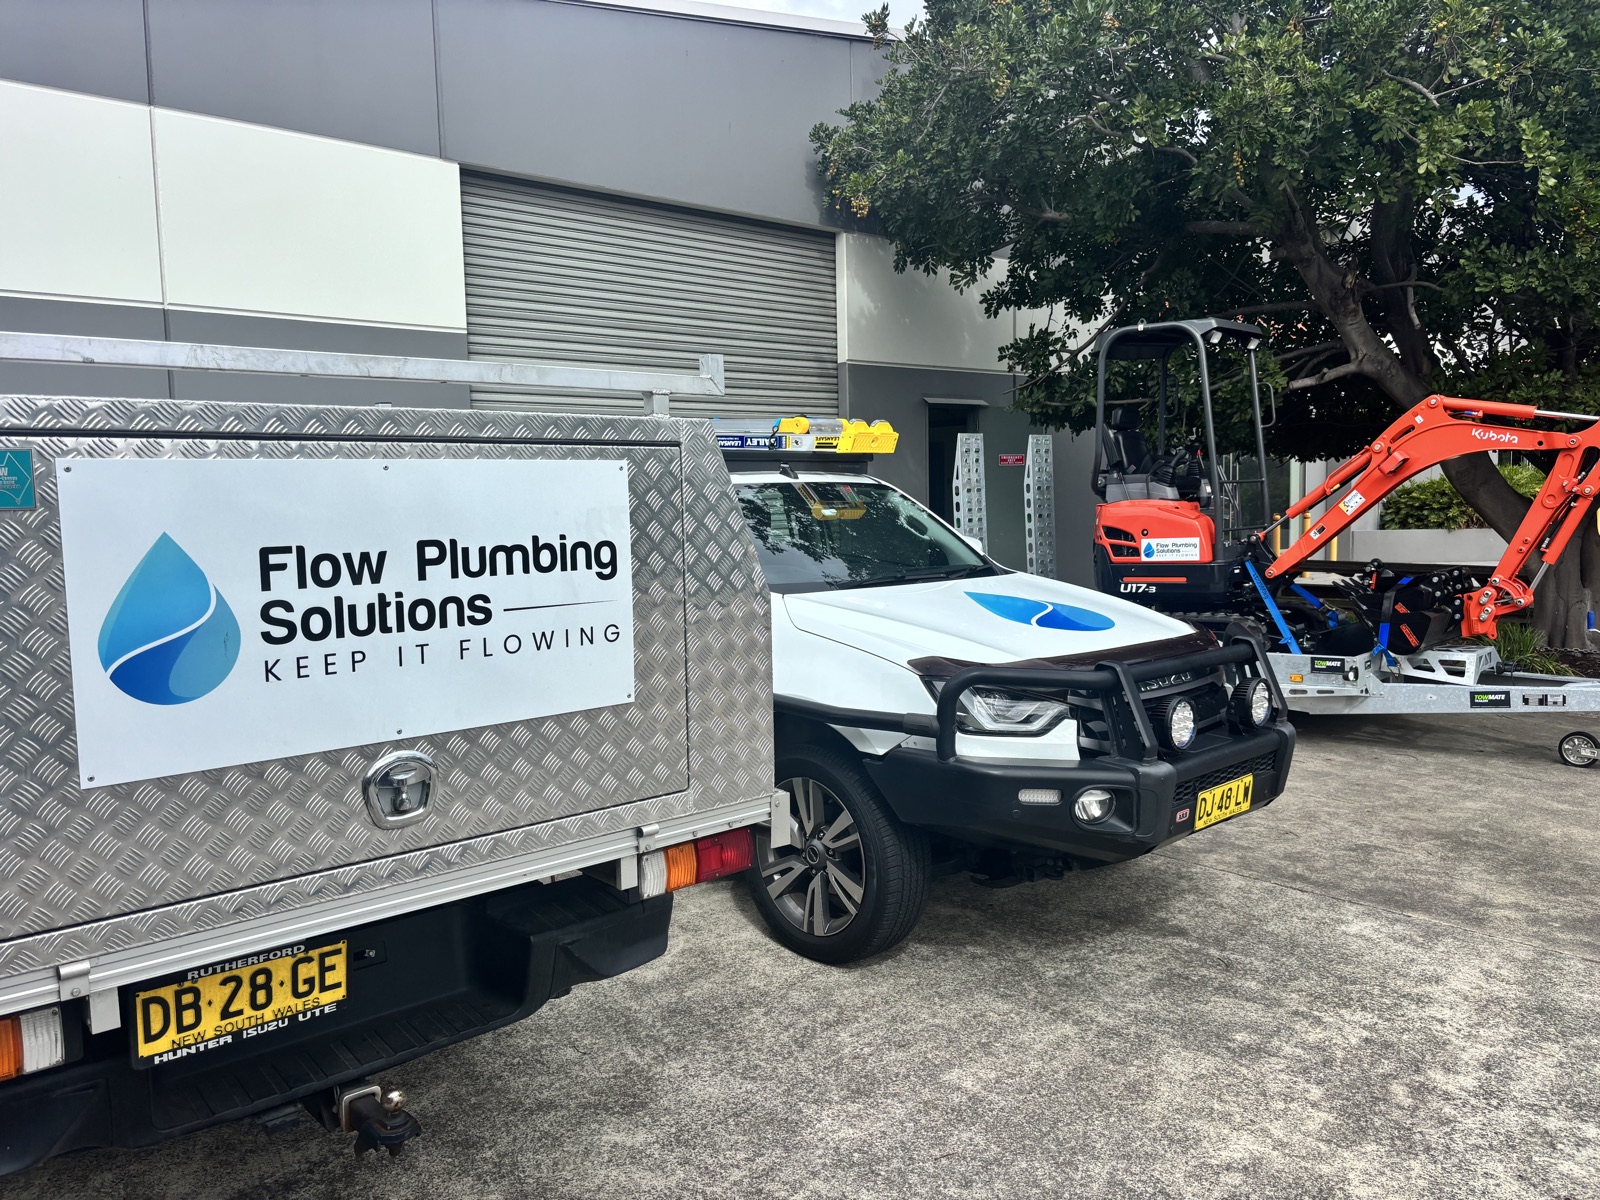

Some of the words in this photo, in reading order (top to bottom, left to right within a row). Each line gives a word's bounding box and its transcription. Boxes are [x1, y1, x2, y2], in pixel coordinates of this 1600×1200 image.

[1471, 428, 1519, 444] Kubota
[258, 545, 388, 592] Flow
[416, 534, 619, 581] Plumbing
[1120, 583, 1157, 594] U17-3
[259, 591, 493, 646] Solutions
[264, 650, 367, 683] KEEP
[398, 643, 430, 668] IT
[460, 624, 621, 660] FLOWING
[187, 945, 306, 980] RUTHERFORD
[154, 1034, 233, 1065] HUNTER
[242, 1018, 289, 1039] ISUZU
[298, 1003, 337, 1022] UTE
[171, 1029, 207, 1050] NEW
[214, 1013, 265, 1036] SOUTH
[272, 997, 321, 1018] WALES
